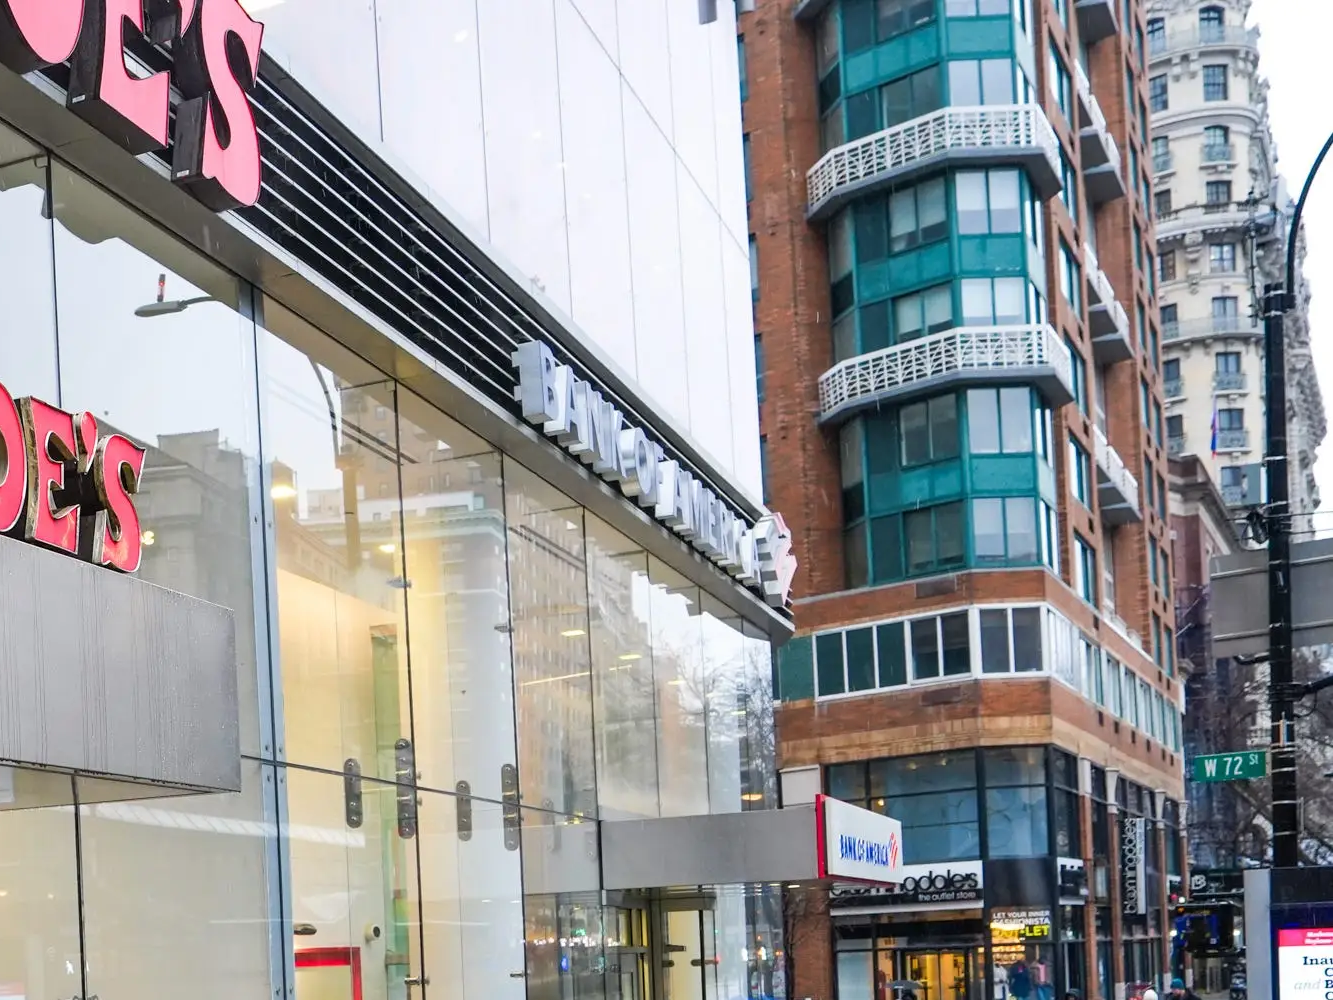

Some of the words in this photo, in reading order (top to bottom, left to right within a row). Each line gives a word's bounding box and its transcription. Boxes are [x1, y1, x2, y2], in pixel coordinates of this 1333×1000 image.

[1204, 759, 1217, 777] W
[1223, 757, 1243, 776] 72
[1249, 754, 1258, 765] St
[840, 833, 857, 862] BANK
[857, 835, 864, 862] OF
[865, 836, 889, 866] AMERICA
[918, 892, 931, 900] the
[932, 891, 955, 900] outlet
[956, 890, 976, 899] store
[1007, 911, 1027, 919] YOUR
